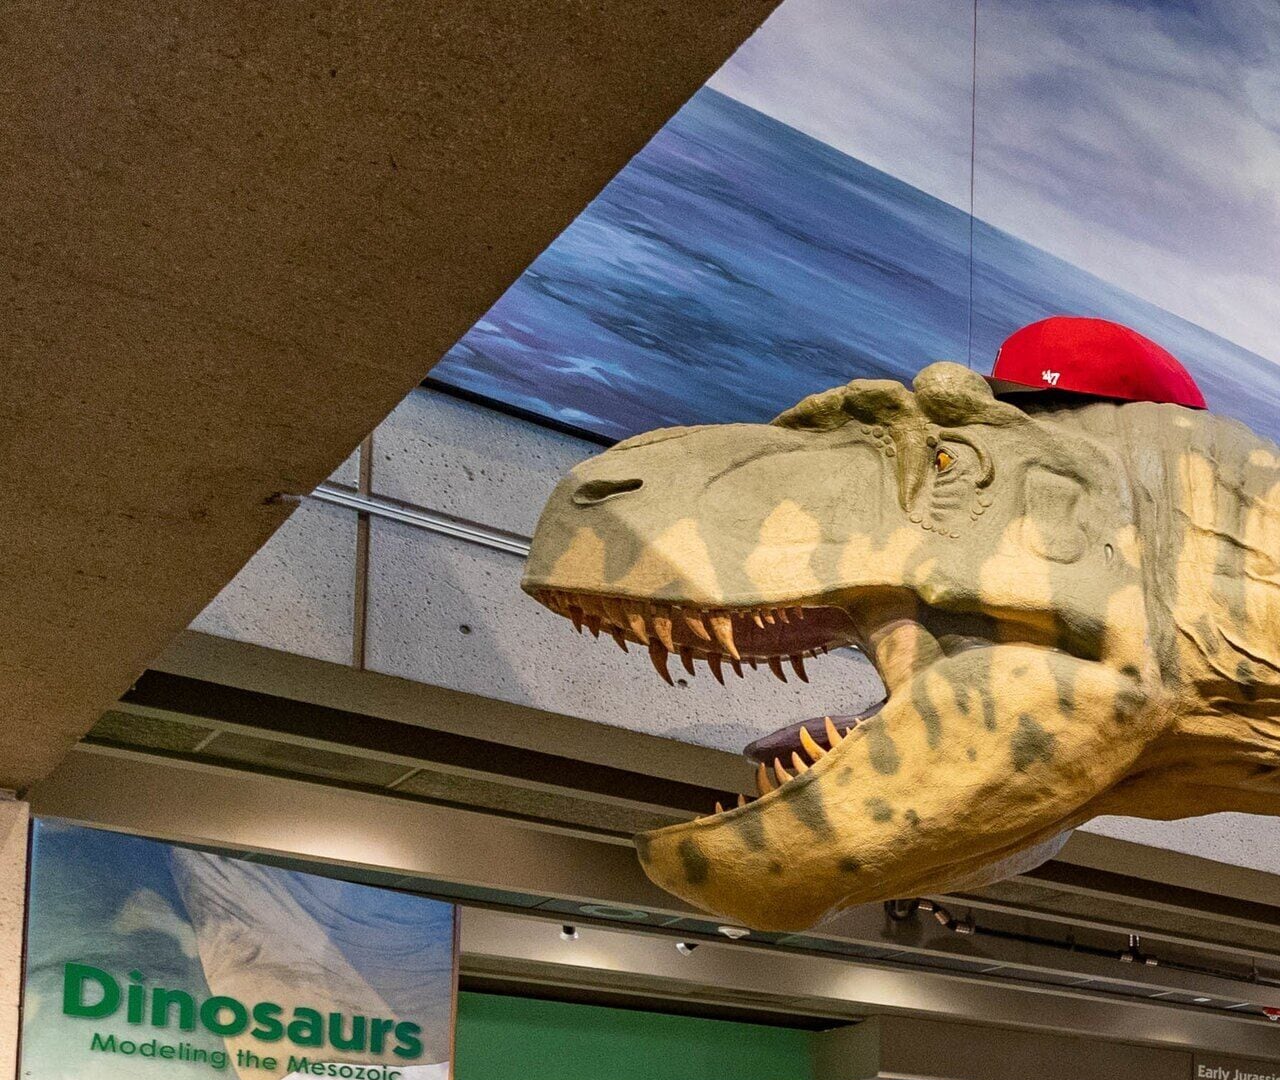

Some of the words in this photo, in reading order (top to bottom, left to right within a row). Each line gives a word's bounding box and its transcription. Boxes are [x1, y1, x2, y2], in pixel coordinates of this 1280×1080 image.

[62, 960, 425, 1060] Dinosaurs
[90, 1032, 229, 1069] Modeling
[237, 1049, 277, 1072] the
